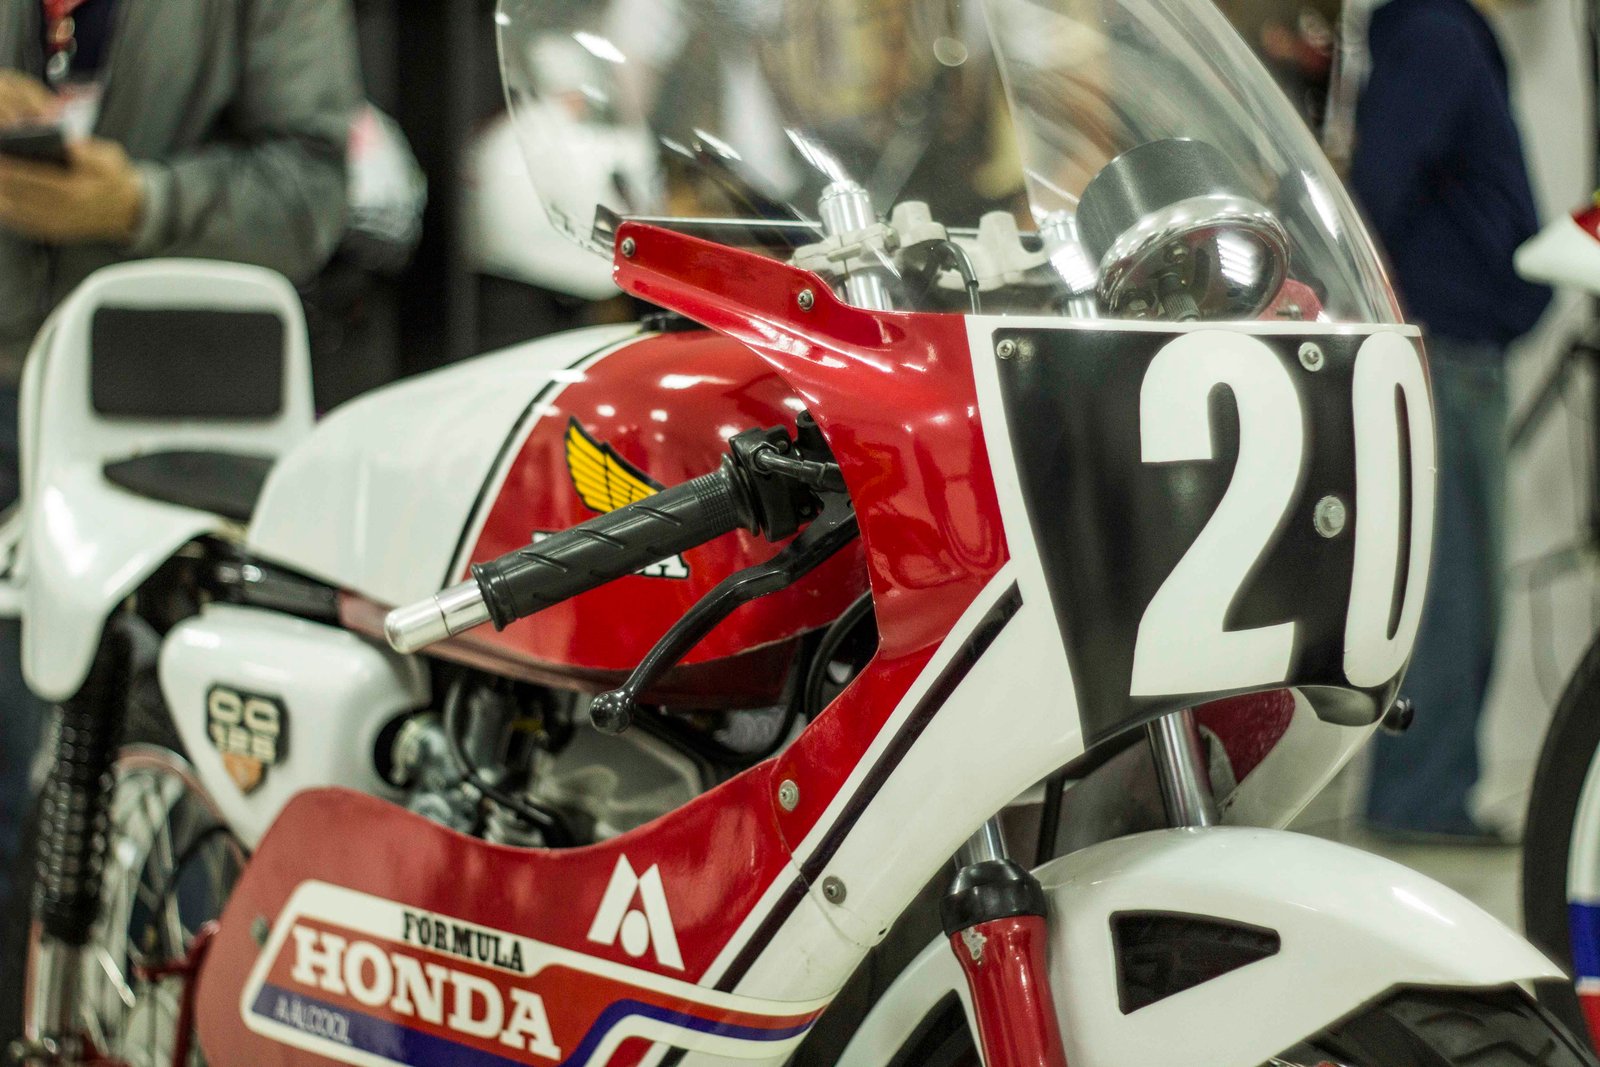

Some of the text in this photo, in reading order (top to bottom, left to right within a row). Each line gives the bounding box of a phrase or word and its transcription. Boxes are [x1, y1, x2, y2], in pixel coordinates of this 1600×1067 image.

[1129, 329, 1435, 696] 20
[291, 924, 561, 1060] HONDA
[403, 911, 525, 972] FORMULA
